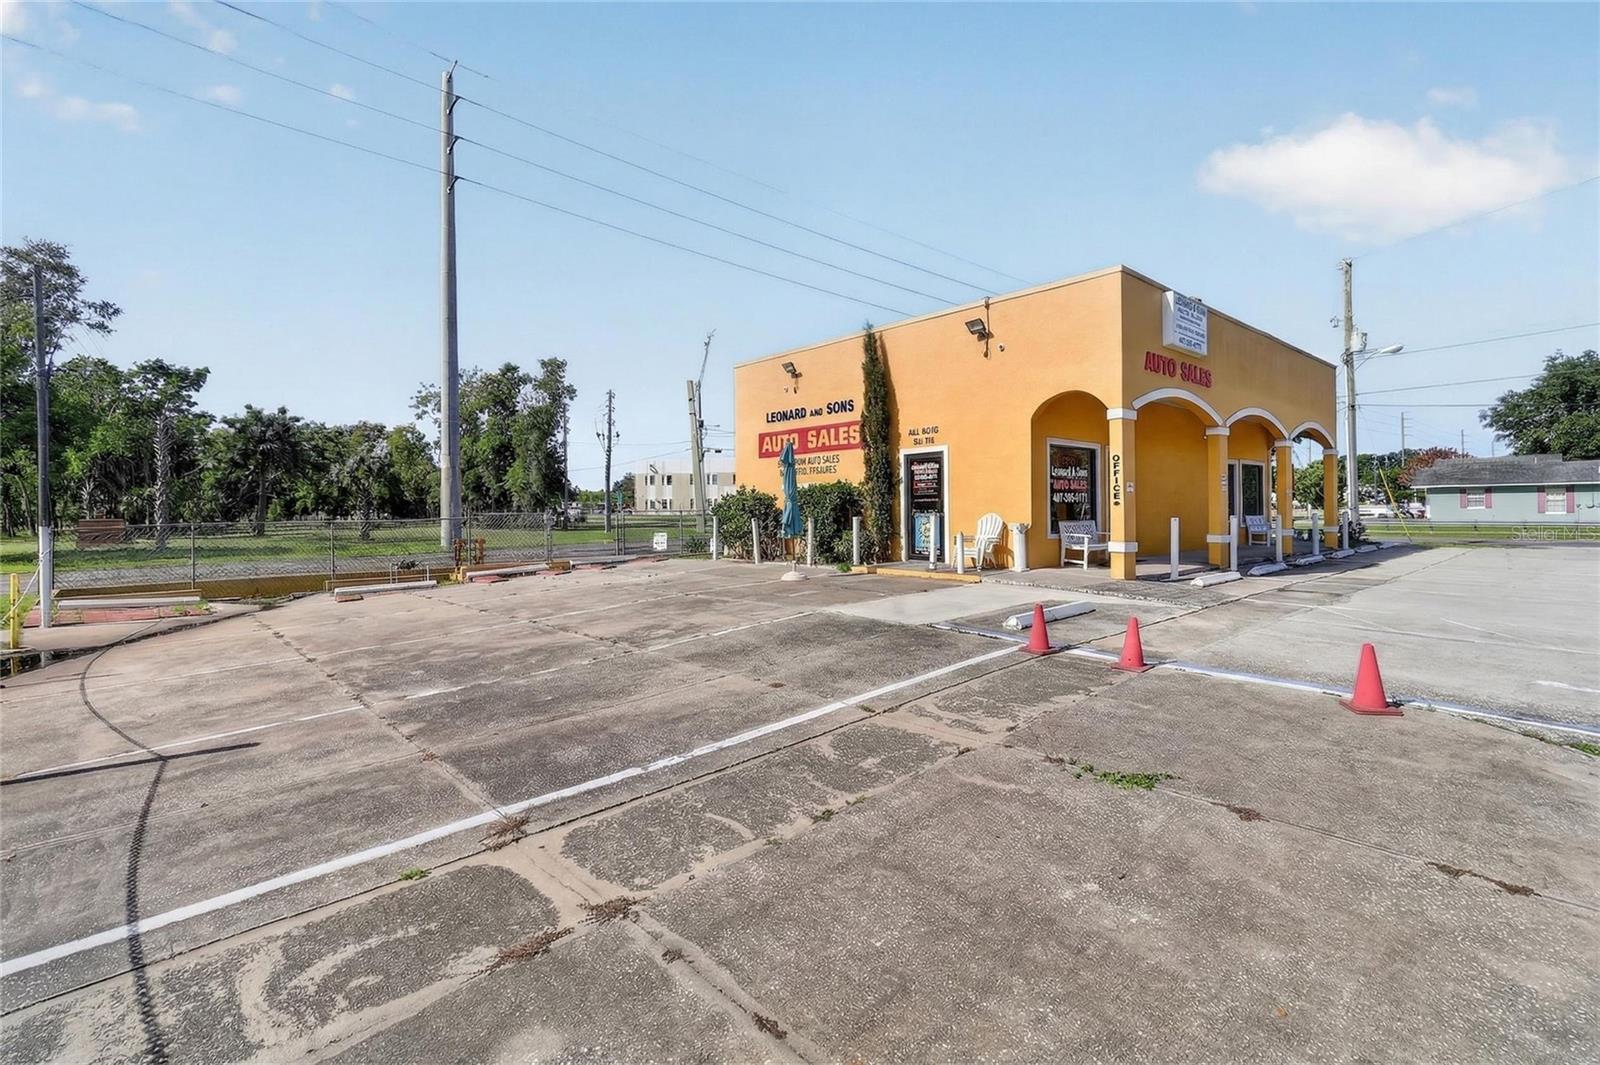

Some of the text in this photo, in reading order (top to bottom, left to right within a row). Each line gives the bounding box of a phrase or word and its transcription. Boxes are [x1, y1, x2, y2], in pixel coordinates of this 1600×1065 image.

[1144, 351, 1213, 389] AUTO SALES
[766, 399, 855, 424] LEONARD AND SONS
[762, 425, 861, 453] AUTO SALES
[822, 454, 840, 464] SALES
[1053, 479, 1088, 490] AUTO SALES
[1112, 454, 1121, 500] OFFICE
